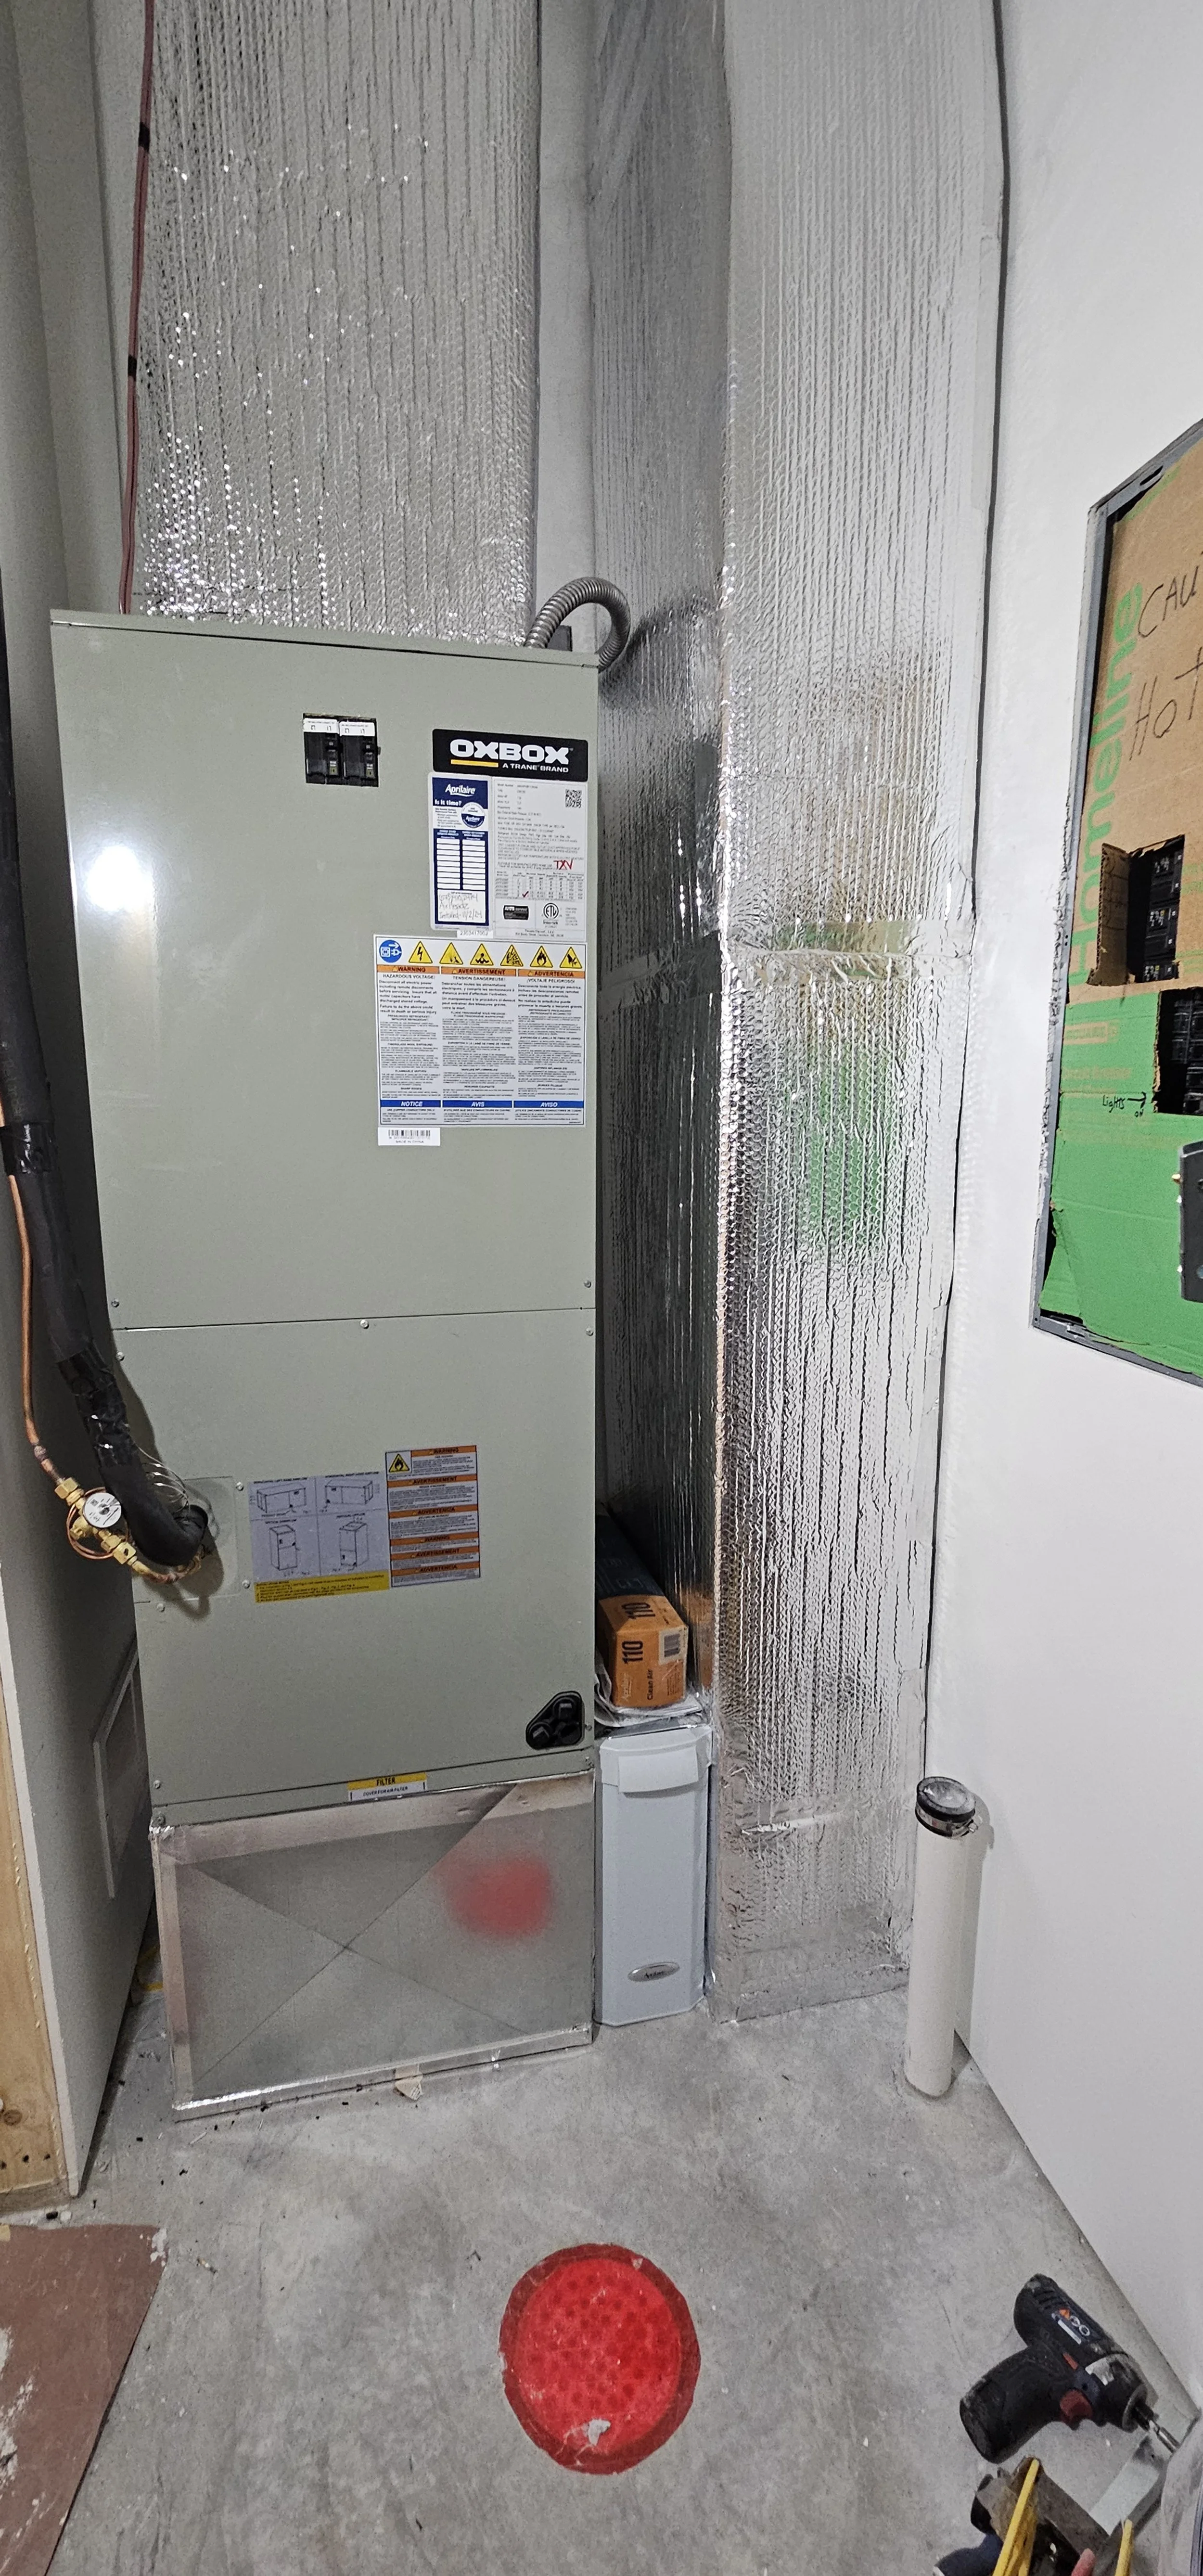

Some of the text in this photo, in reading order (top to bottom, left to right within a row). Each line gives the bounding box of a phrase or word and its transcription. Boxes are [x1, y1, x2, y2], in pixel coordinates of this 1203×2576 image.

[1138, 551, 1203, 638] CAU
[450, 739, 569, 764] OXBOX
[445, 784, 475, 796] Aprilaire
[553, 859, 573, 870] TXV
[622, 1602, 656, 1619] 110
[622, 1640, 643, 1664] 110
[376, 1777, 396, 1786] FILTER
